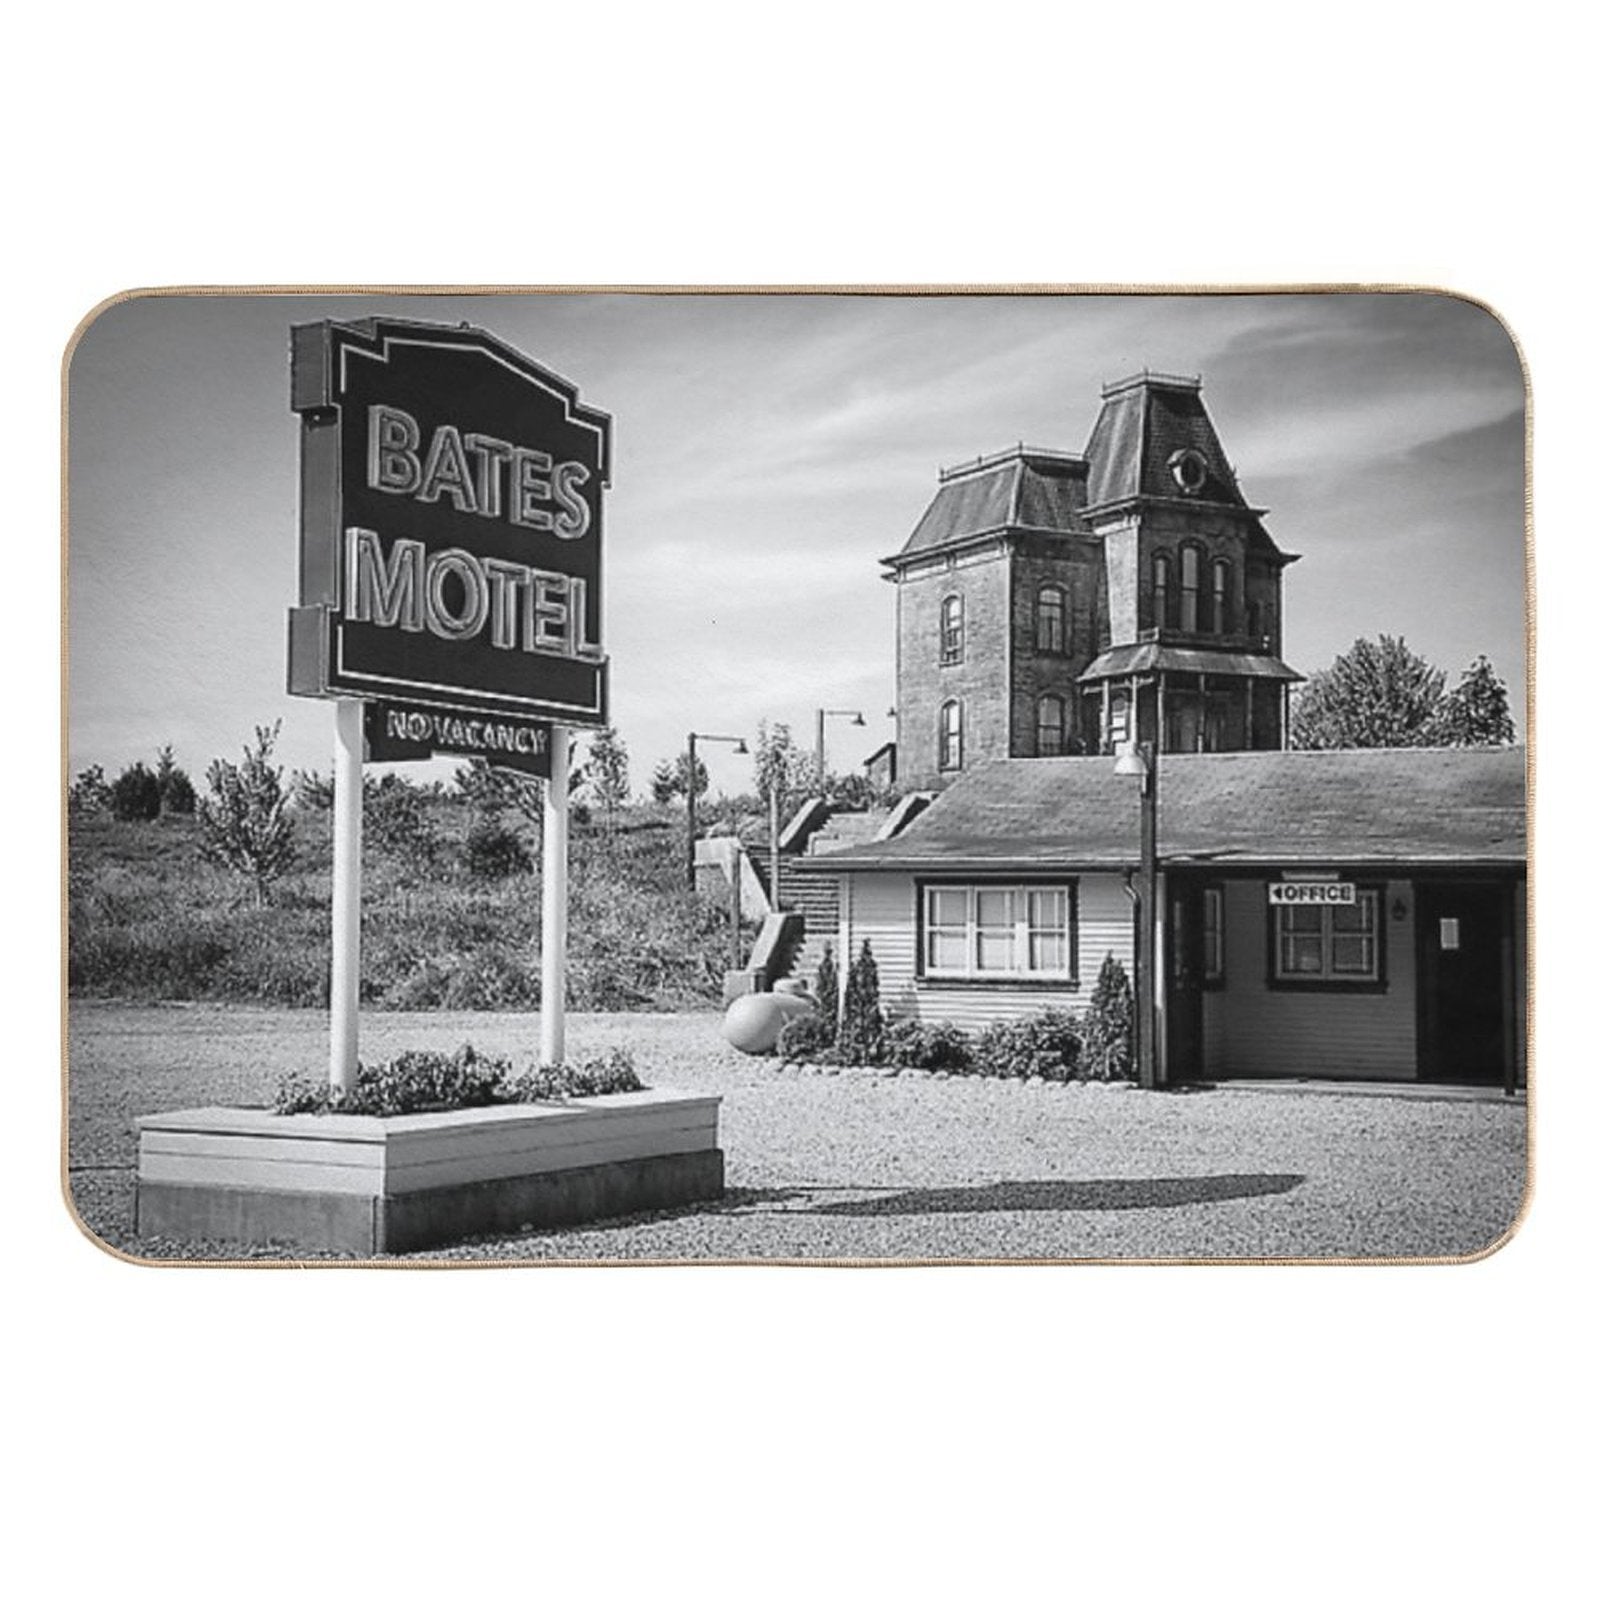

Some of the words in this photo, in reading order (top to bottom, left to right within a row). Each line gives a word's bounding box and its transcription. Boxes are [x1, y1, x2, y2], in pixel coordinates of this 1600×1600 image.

[367, 404, 591, 539] BATES
[345, 527, 604, 660] MOTEL
[387, 710, 432, 741] NO
[434, 715, 547, 754] VACANCY
[1284, 884, 1351, 901] OFFICE
